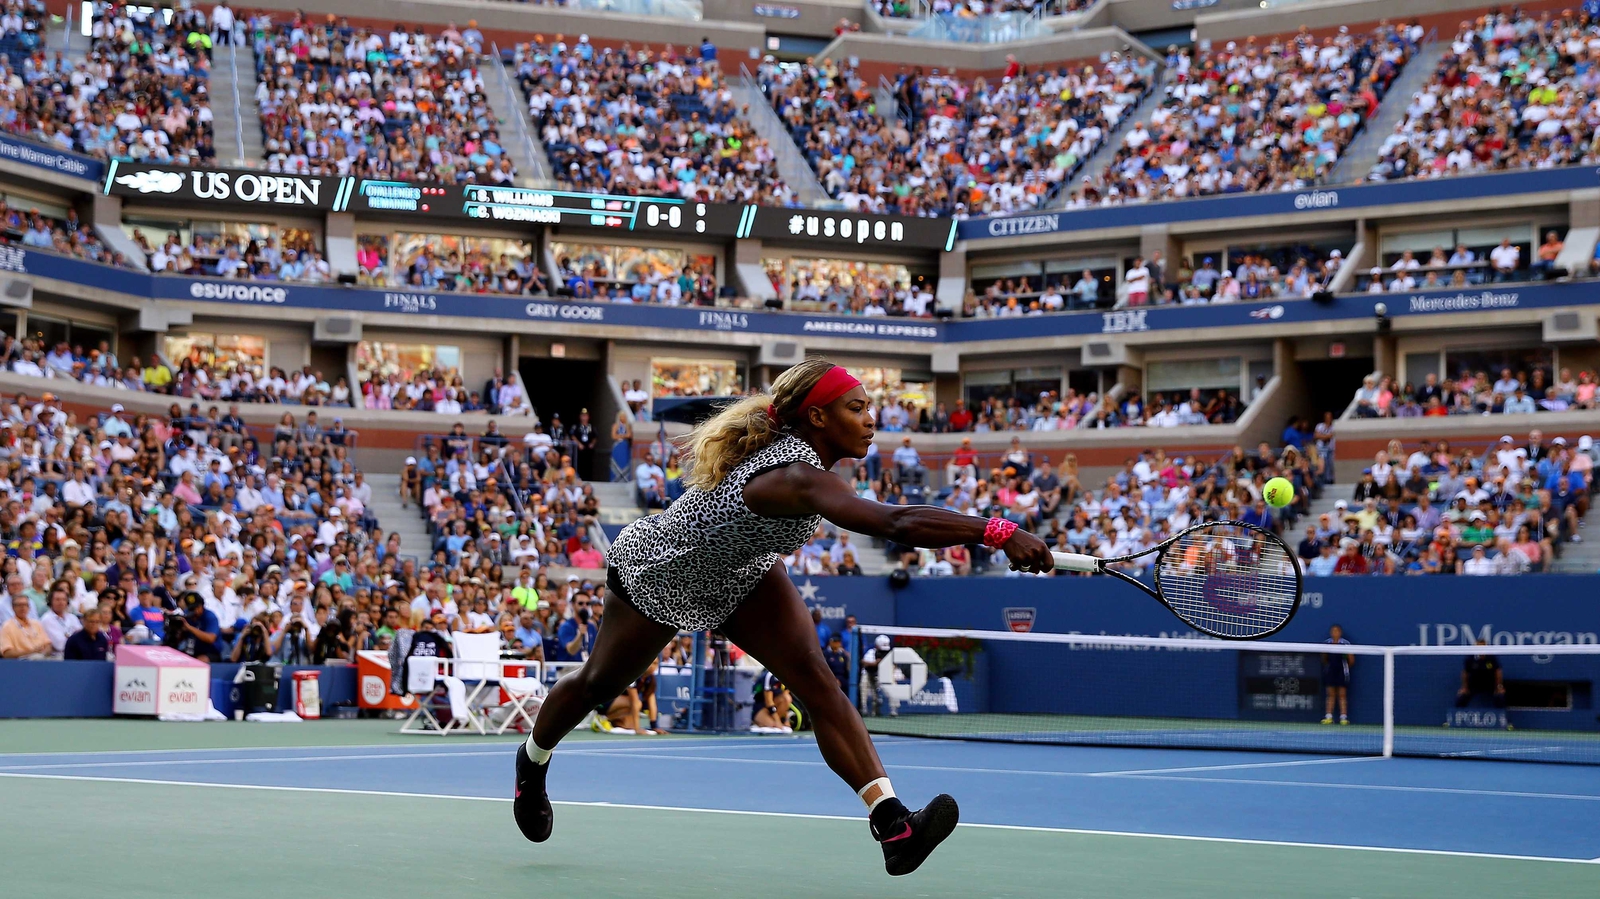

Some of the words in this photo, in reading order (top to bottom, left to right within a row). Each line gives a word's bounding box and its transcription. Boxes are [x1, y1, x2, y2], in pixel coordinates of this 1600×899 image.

[0, 142, 20, 158] ime
[19, 145, 55, 167] Warner
[55, 155, 87, 175] Cable
[191, 170, 230, 199] US
[234, 173, 322, 205] OPEN
[365, 185, 421, 200] CHALLENGES
[368, 196, 417, 211] REMAINING
[493, 190, 554, 207] WILLIAMS
[1294, 189, 1339, 210] evian
[492, 206, 561, 224] WOZNIACKI
[788, 214, 904, 244] #usopen
[988, 213, 1060, 237] CITIZEN
[190, 281, 287, 303] esurance
[384, 292, 437, 311] FINALS
[525, 302, 559, 318] GREY
[560, 304, 605, 321] GOOSE
[699, 311, 748, 329] FINALS
[803, 321, 875, 334] AMERICAN
[877, 324, 937, 338] EXPRESS
[1101, 309, 1148, 333] IBM
[1259, 655, 1305, 675] IBM
[119, 690, 152, 703] evian
[169, 691, 198, 704] evian
[1276, 694, 1314, 710] MPH
[1455, 711, 1497, 728] POLO
